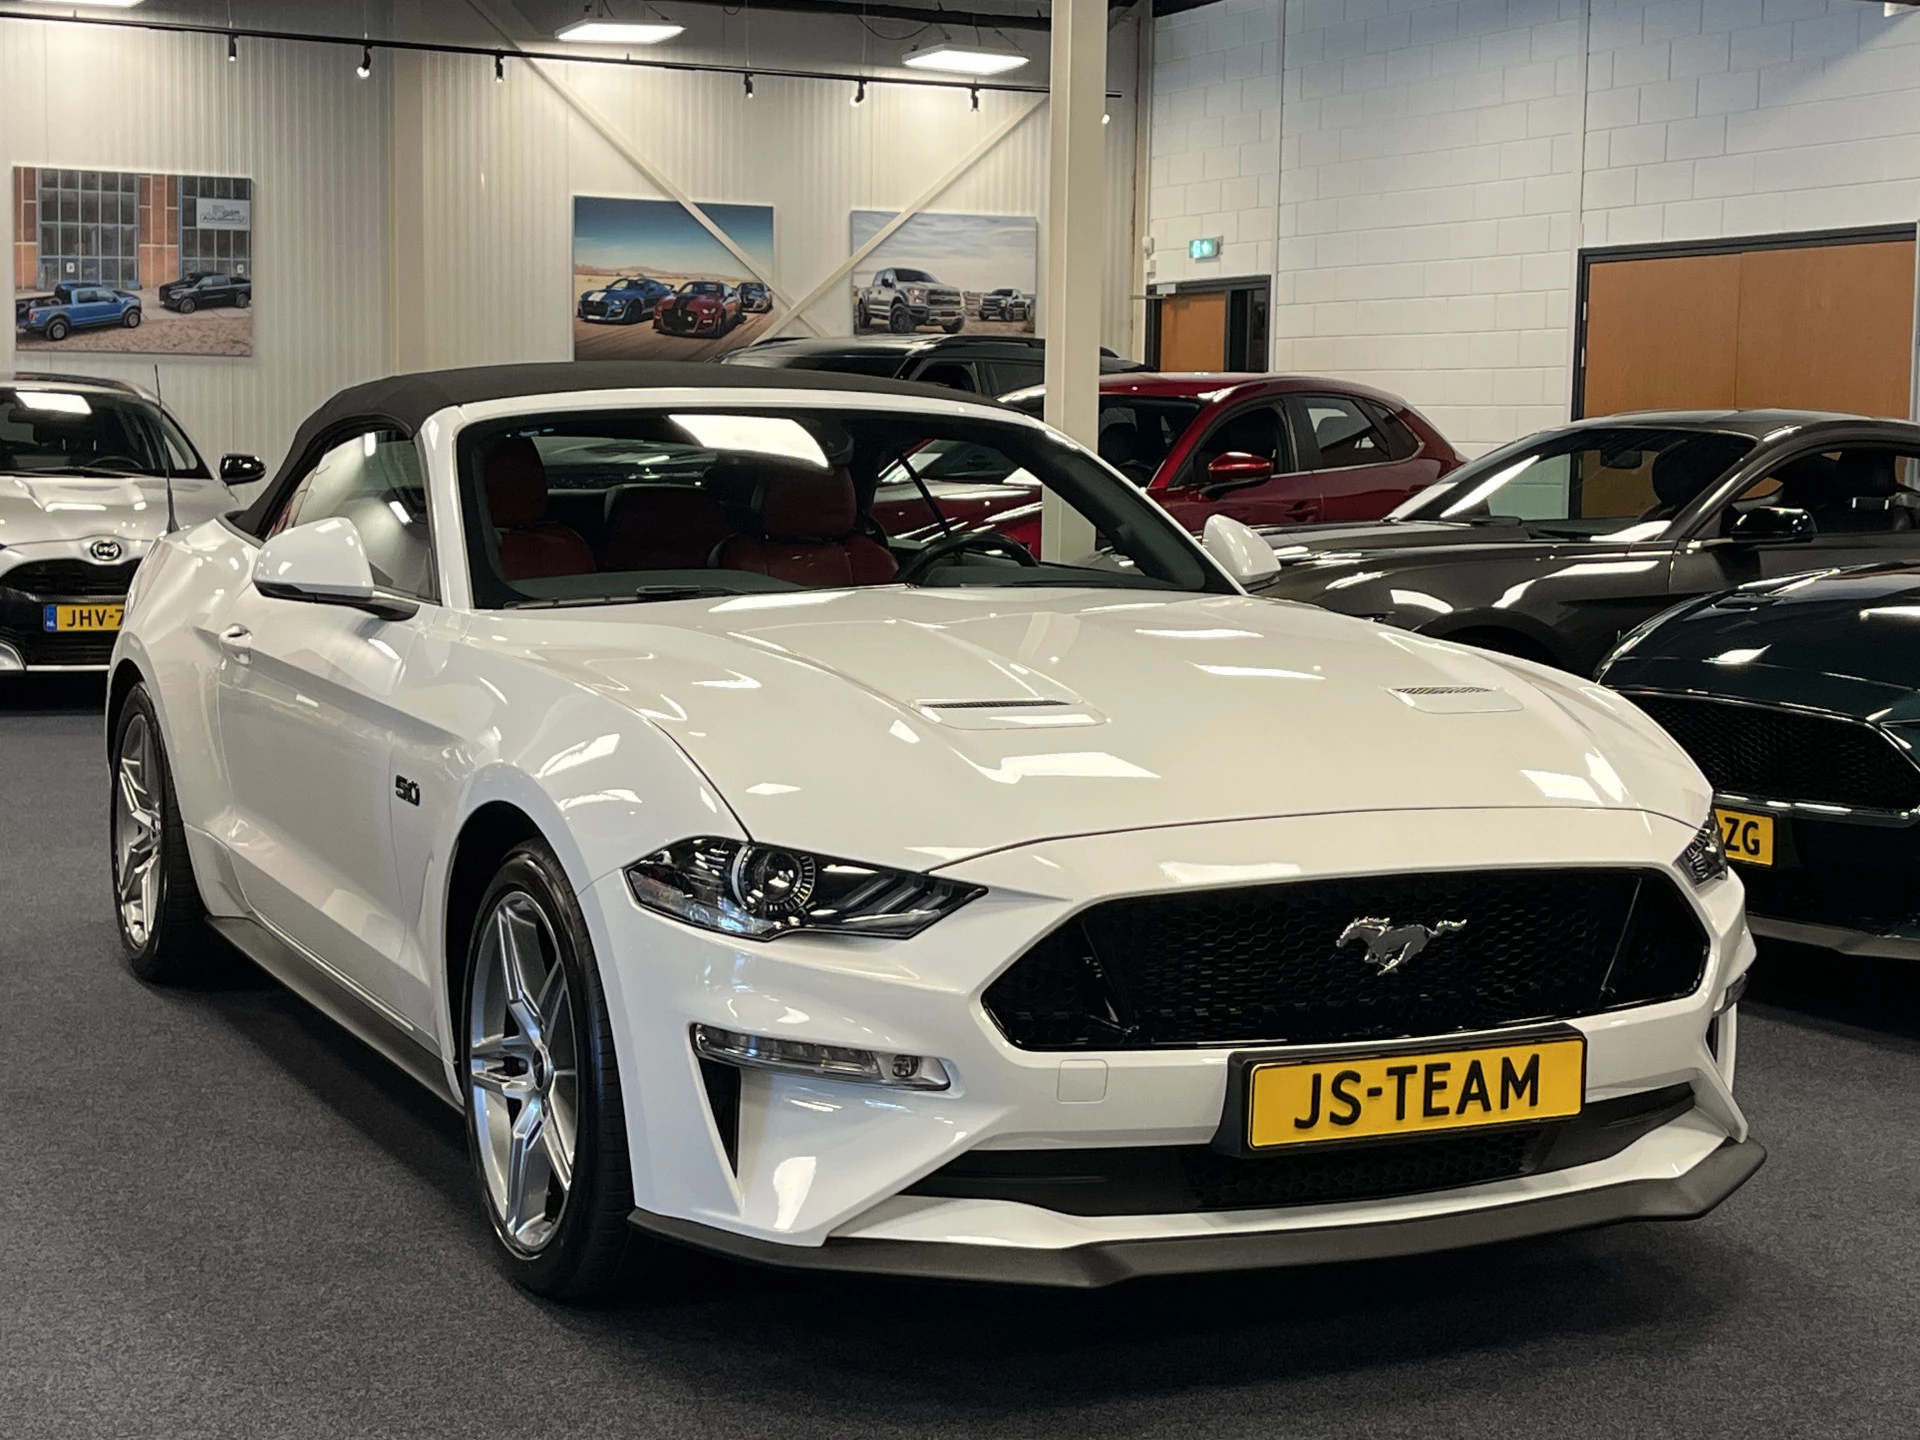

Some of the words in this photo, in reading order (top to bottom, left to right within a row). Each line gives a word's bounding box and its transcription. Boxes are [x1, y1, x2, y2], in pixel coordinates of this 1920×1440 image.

[66, 609, 124, 627] JHV-7
[1721, 816, 1761, 856] ZG
[1294, 1053, 1540, 1130] JS-TEAM
